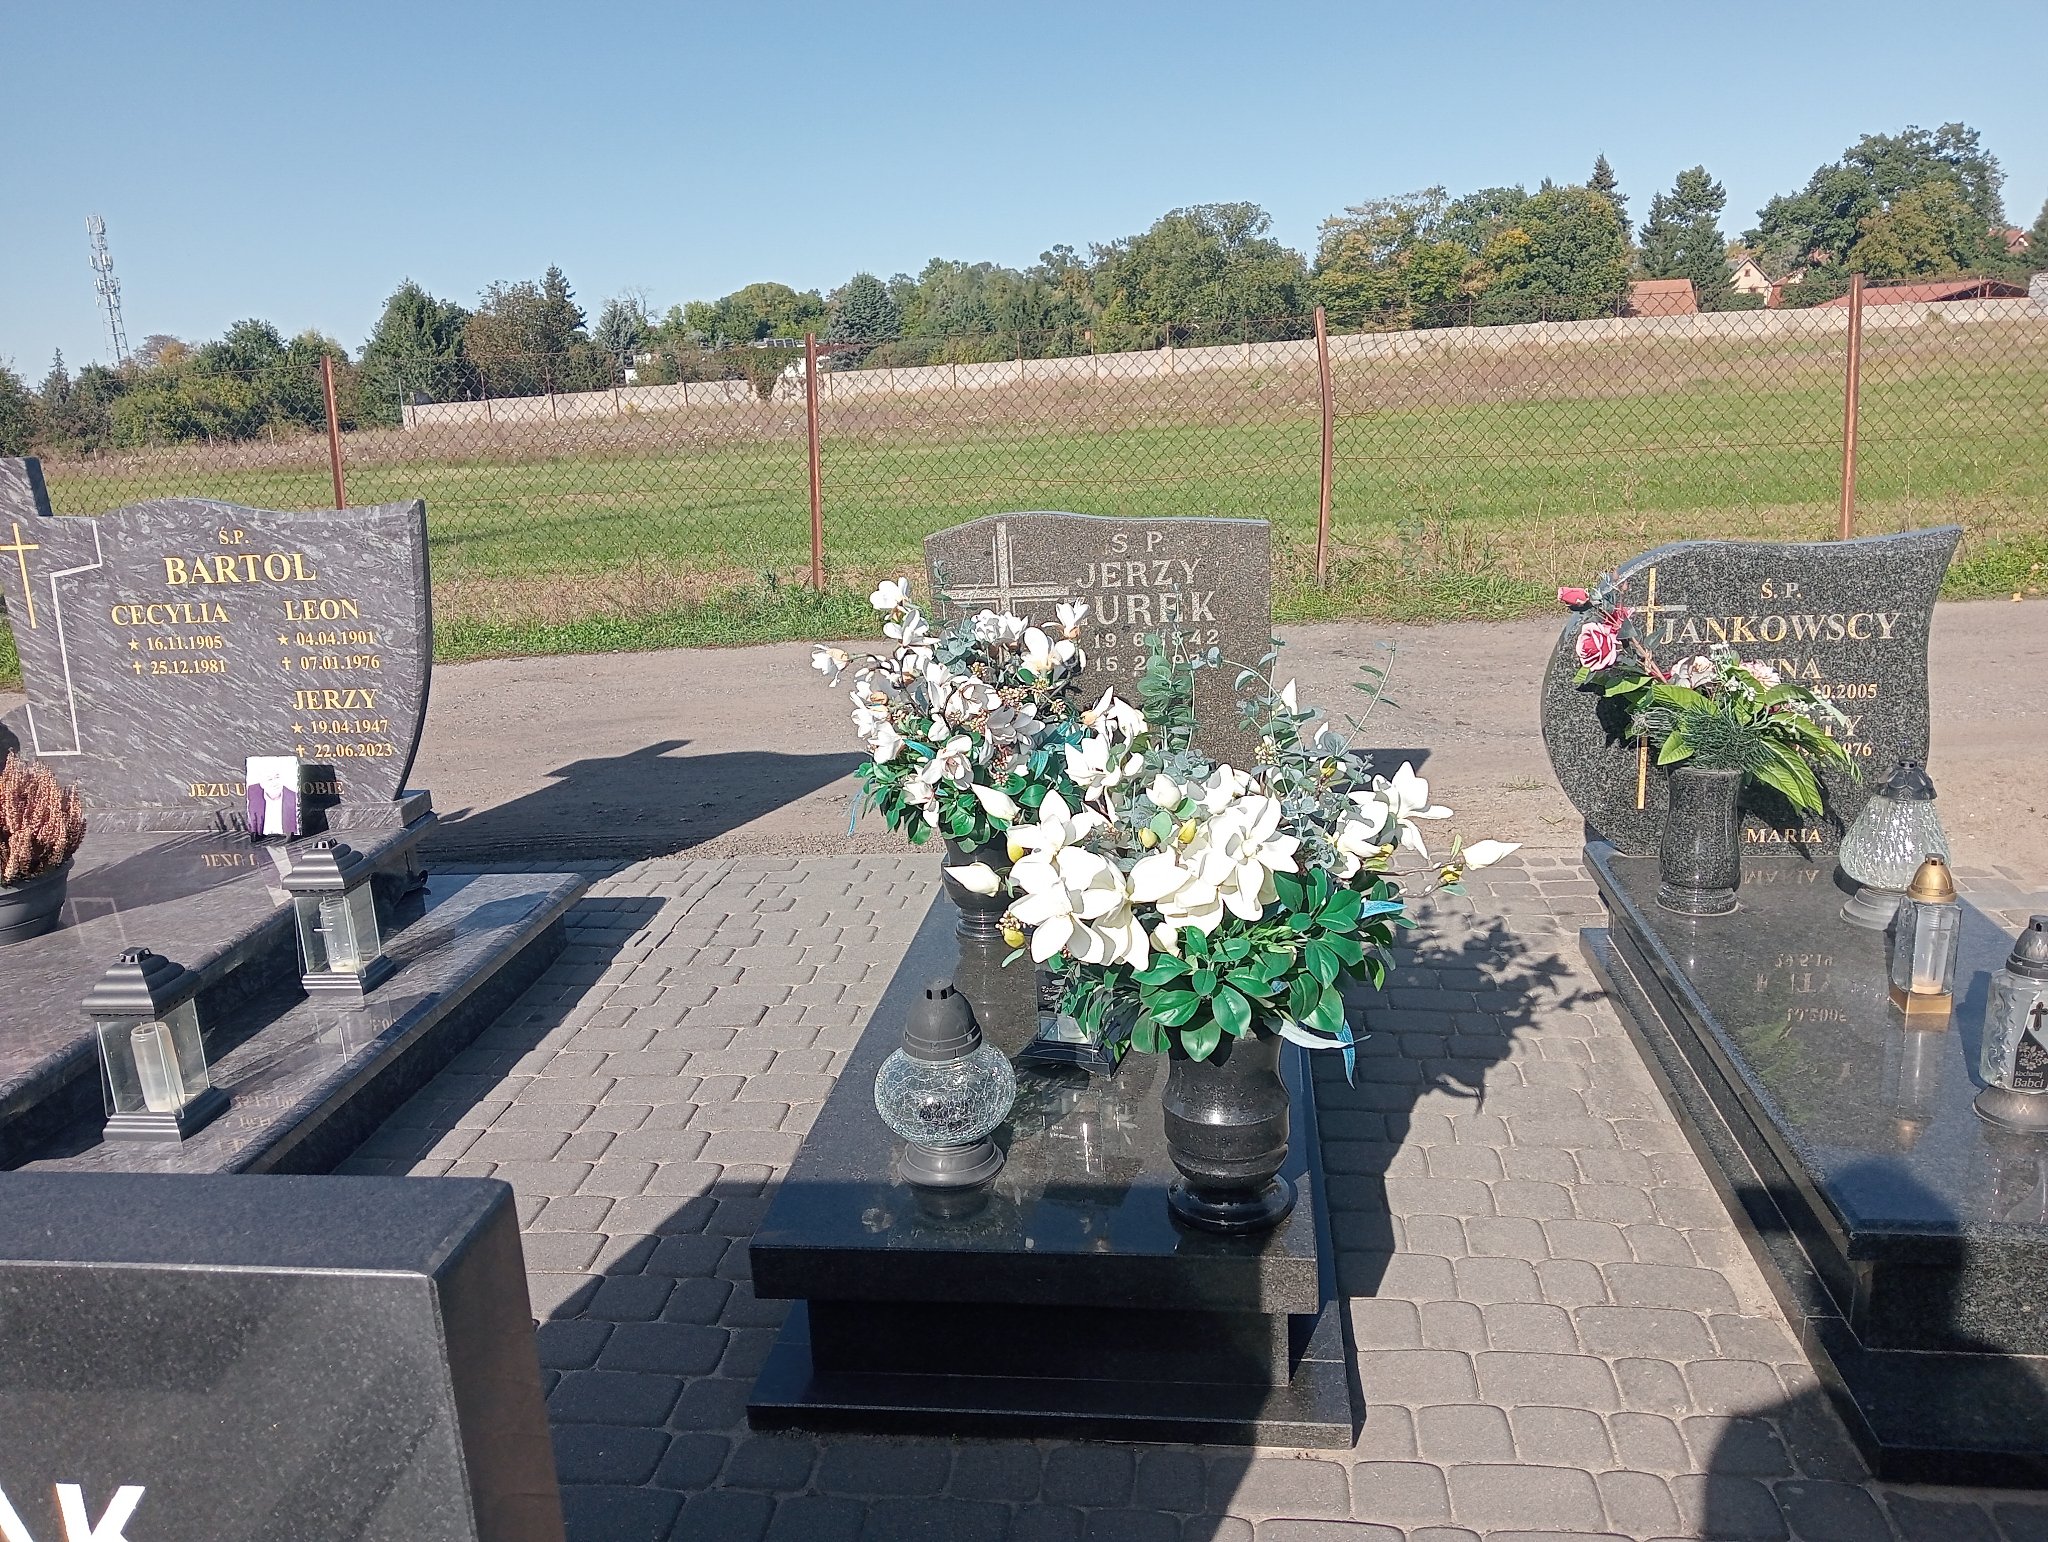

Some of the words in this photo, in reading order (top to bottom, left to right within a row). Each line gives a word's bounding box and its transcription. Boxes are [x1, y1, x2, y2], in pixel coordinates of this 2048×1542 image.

[162, 553, 317, 586] BARTOL
[1076, 557, 1202, 589] JERZY
[111, 602, 230, 626] CECYLIA
[283, 598, 360, 621] LEON
[1660, 612, 1901, 645] JANKOWSCY
[146, 635, 223, 651] 16.11.1905
[296, 630, 376, 646] 04.04.1901
[151, 659, 226, 675] 25.12.1981
[300, 655, 380, 671] 07.01.1976
[292, 688, 377, 710] JERZY
[311, 719, 389, 734] 19.04.1947
[314, 743, 393, 758] 22.06.2023
[188, 782, 231, 797] JEZU
[302, 781, 345, 796] OBIE
[1746, 828, 1823, 844] MARIA
